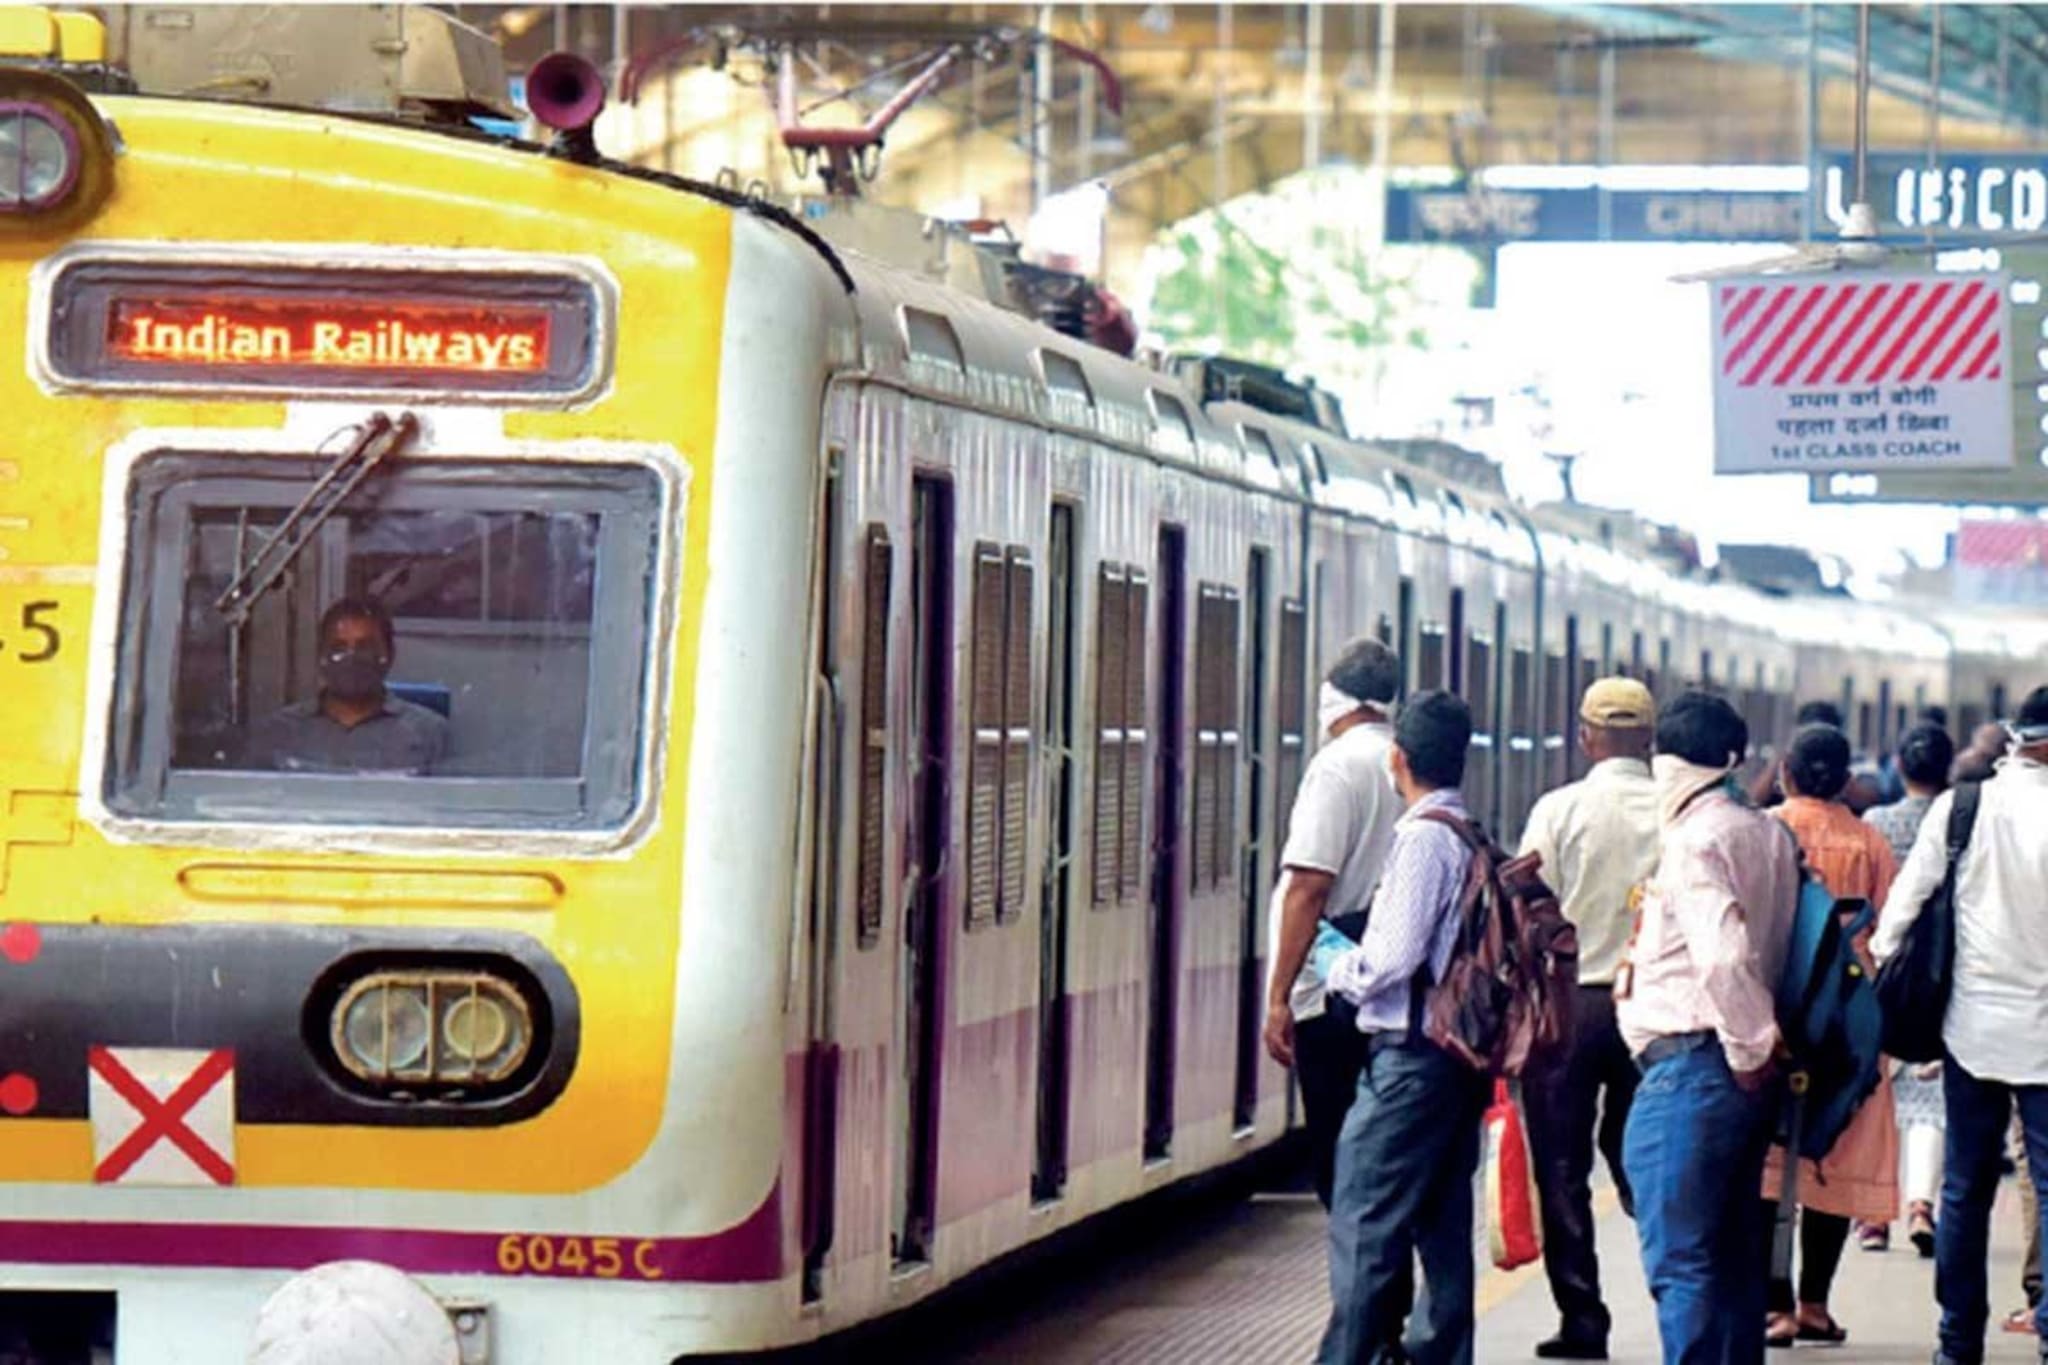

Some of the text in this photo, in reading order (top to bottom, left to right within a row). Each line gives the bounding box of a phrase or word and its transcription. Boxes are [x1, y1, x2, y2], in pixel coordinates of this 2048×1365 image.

[132, 316, 534, 370] Indian Railways
[1788, 384, 1938, 408] प्रथम वर्ग बोगी
[1776, 417, 1836, 436] पहला
[1771, 440, 1962, 460] 1st CLASS COACH
[498, 1234, 662, 1278] 6045 C
